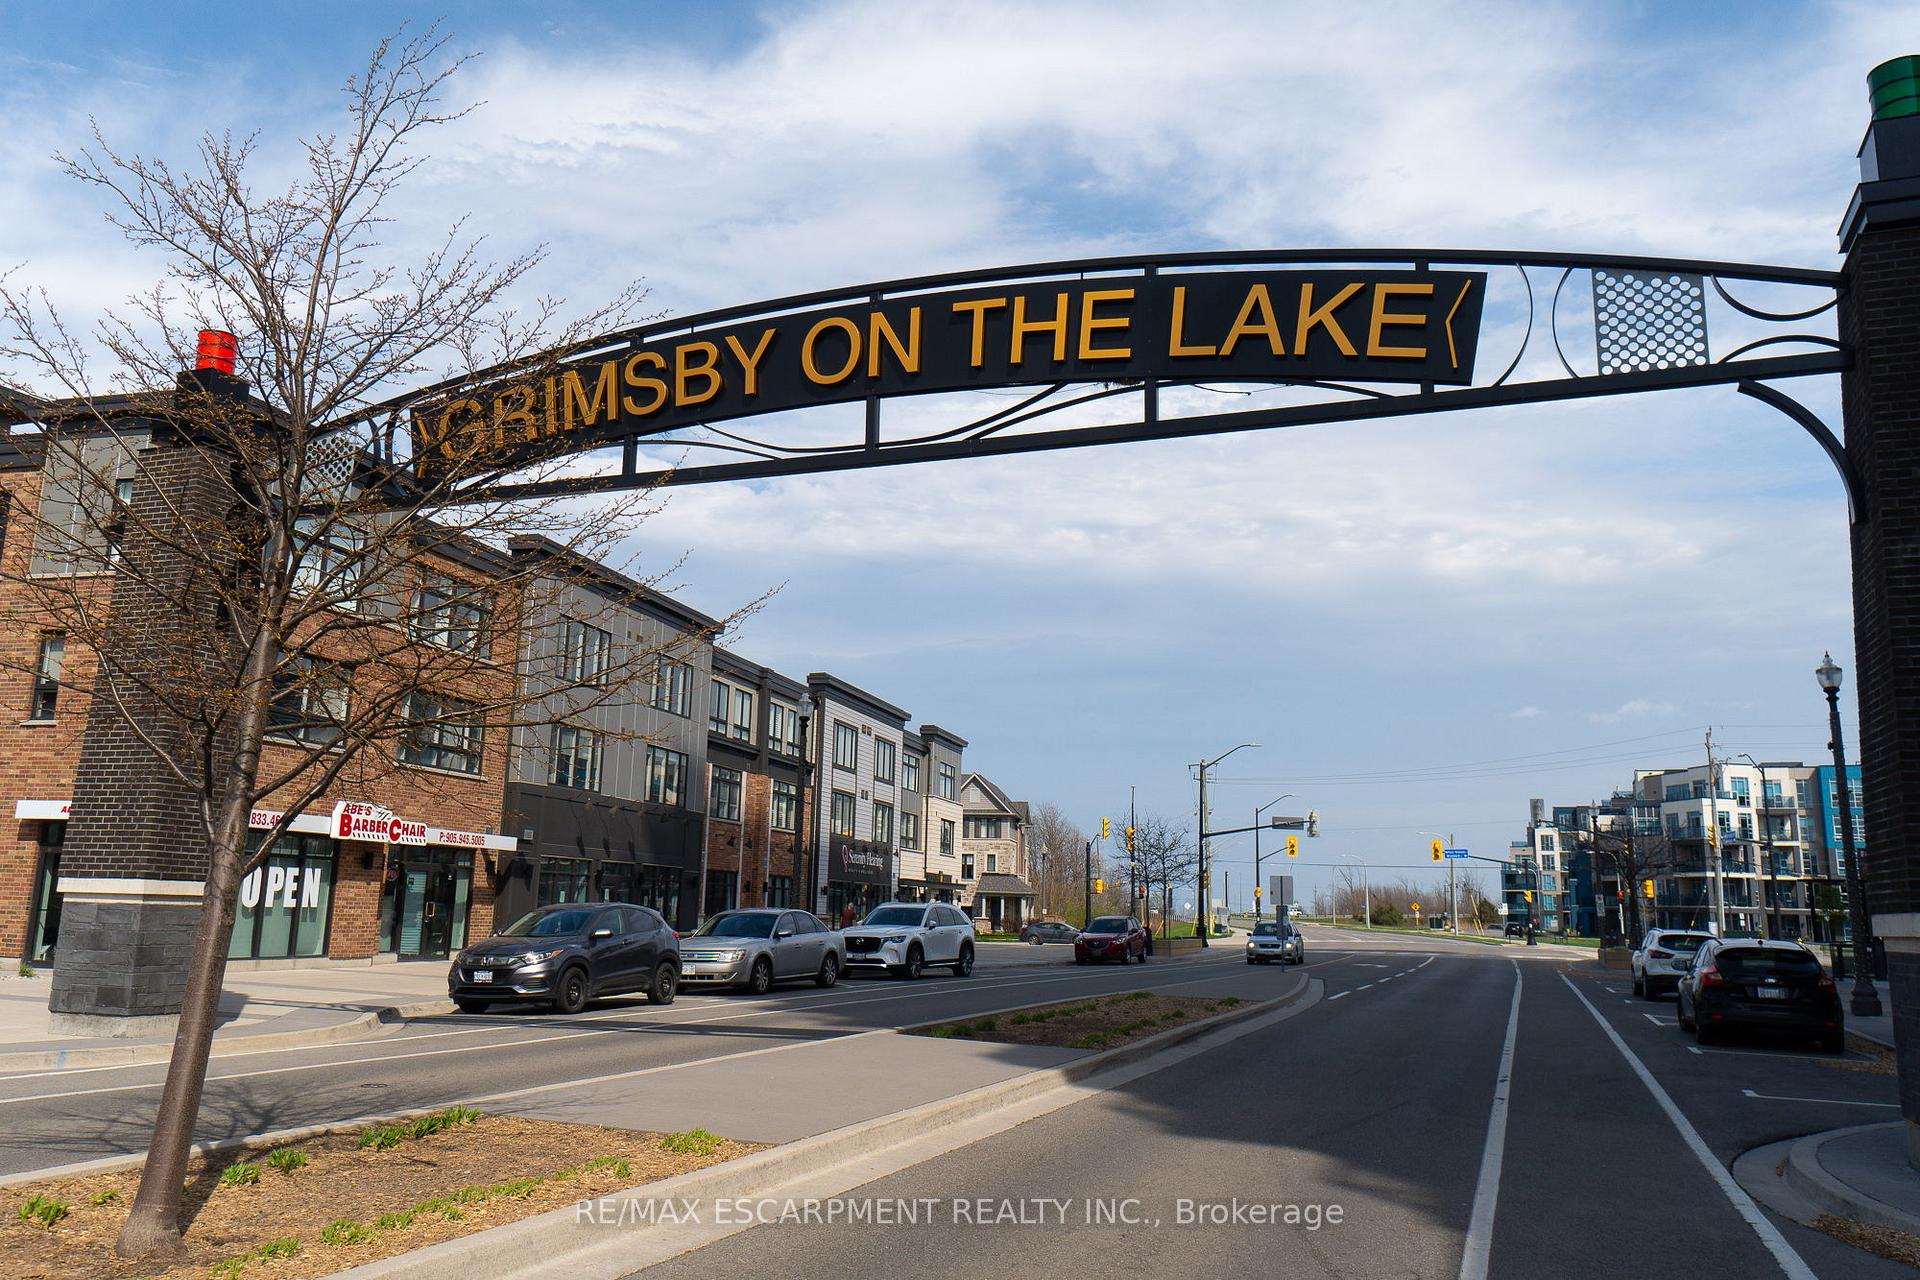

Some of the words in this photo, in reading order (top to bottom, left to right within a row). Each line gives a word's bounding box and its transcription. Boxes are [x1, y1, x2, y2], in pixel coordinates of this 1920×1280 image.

[438, 328, 777, 460] GRIMSBY
[801, 305, 921, 385] ON
[952, 288, 1135, 367] THE
[1169, 282, 1434, 358] LAKE
[342, 803, 373, 816] ABE'S
[241, 866, 321, 908] OPEN
